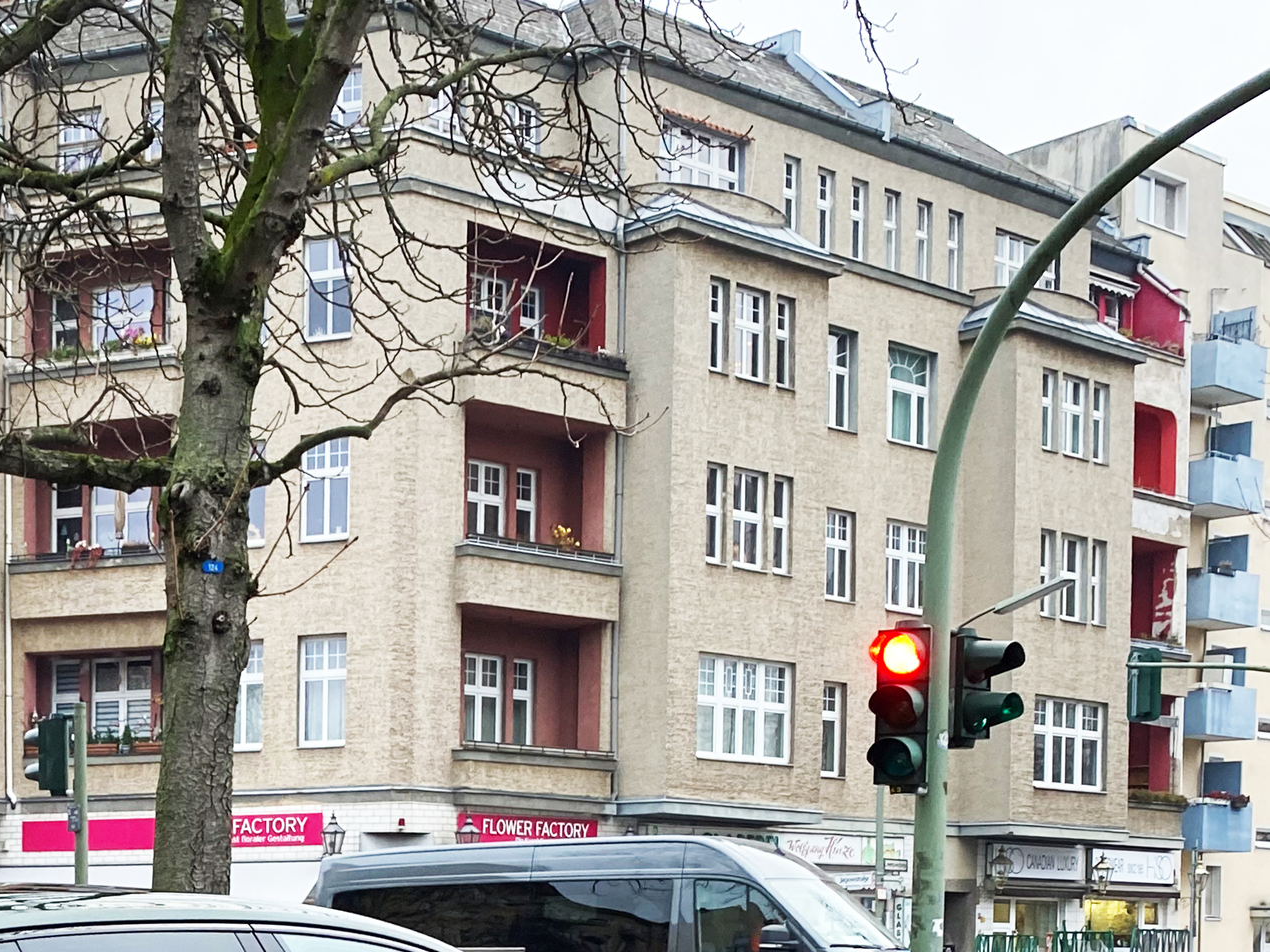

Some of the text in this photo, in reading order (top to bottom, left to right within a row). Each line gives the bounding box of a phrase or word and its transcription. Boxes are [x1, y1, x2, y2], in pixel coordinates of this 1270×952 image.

[232, 817, 308, 834] FACTORY
[482, 818, 590, 838] FLOWER FACTORY
